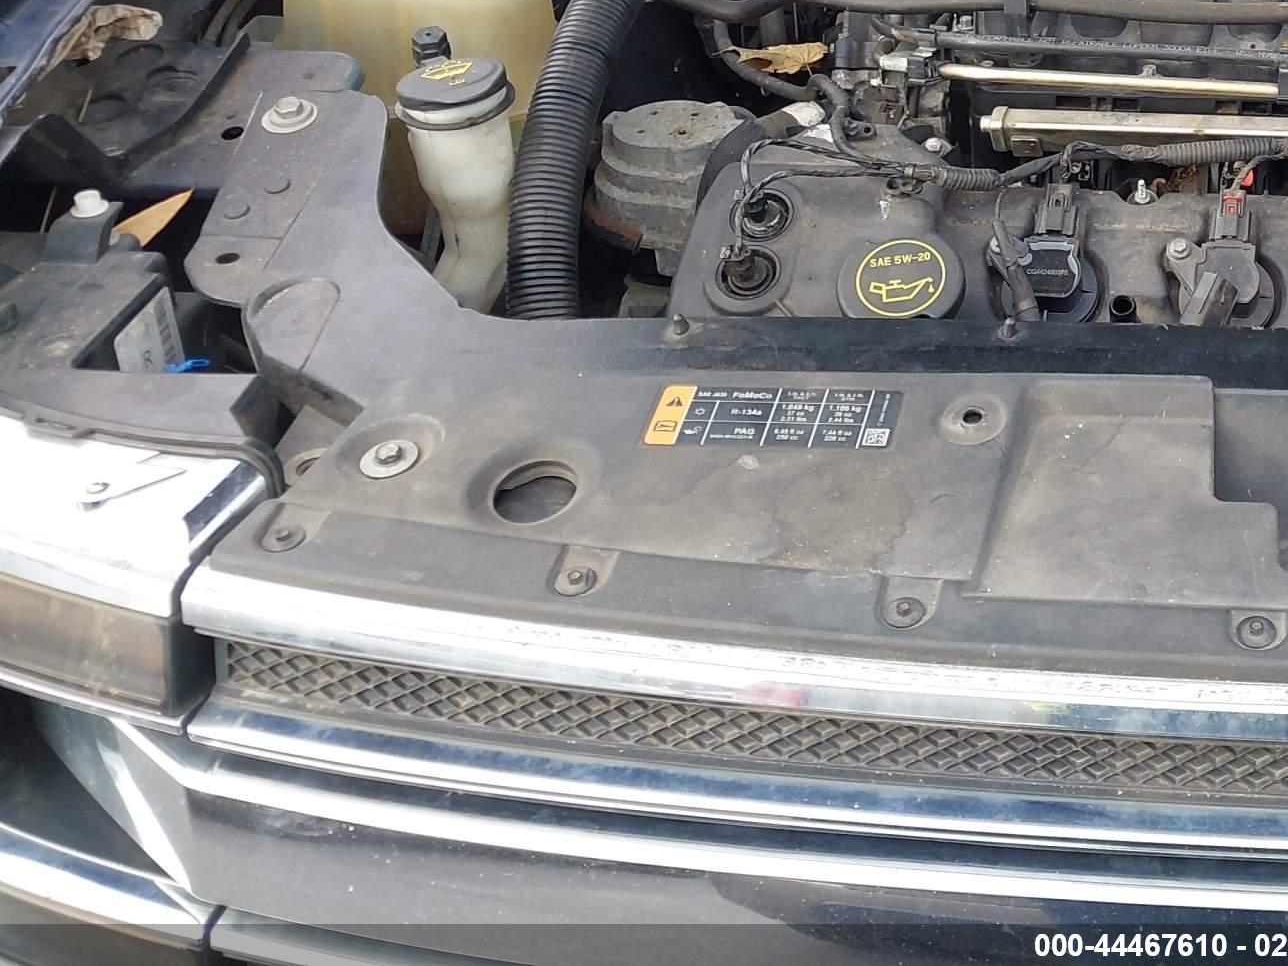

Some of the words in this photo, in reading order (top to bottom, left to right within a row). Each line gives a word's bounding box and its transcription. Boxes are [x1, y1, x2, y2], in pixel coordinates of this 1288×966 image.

[869, 256, 892, 268] SAE
[894, 251, 931, 265] 5W-20
[732, 391, 773, 399] FoMoCo
[730, 408, 763, 416] R-134a
[804, 404, 815, 412] kg
[851, 405, 861, 413] kg
[733, 427, 755, 435] PAG
